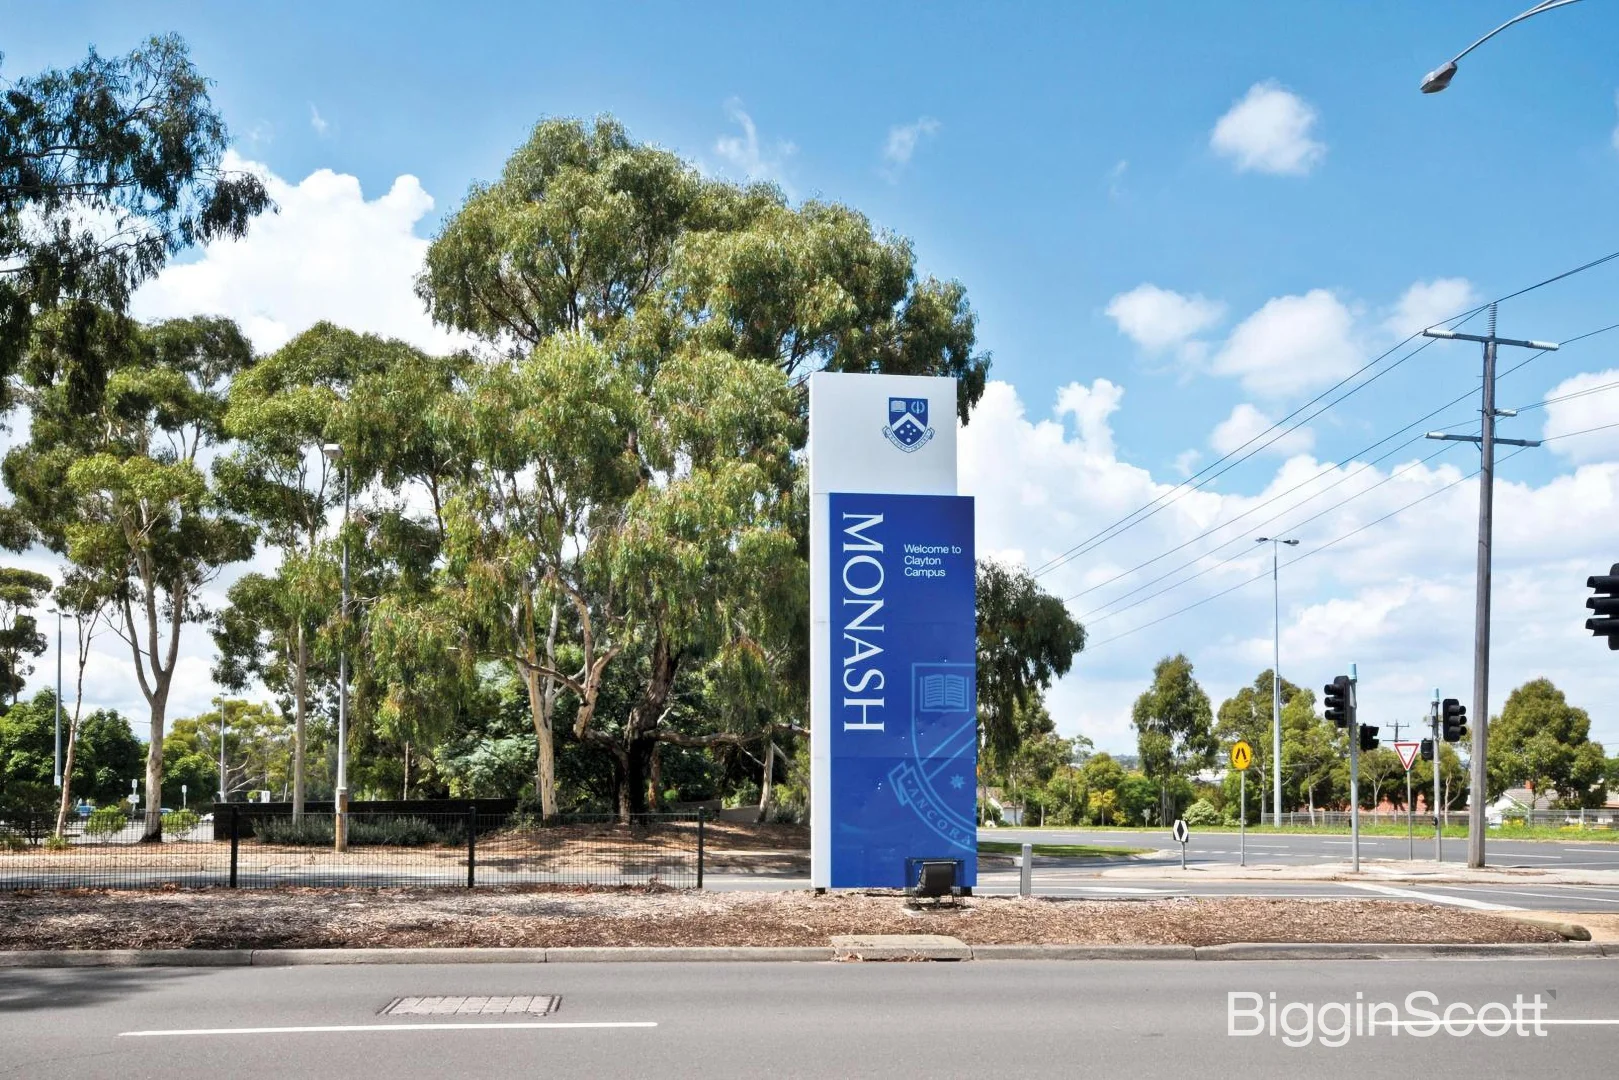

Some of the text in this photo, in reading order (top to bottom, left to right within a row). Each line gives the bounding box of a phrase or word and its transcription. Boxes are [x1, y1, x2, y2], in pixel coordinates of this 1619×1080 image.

[903, 543, 962, 554] Welcome to
[904, 555, 941, 567] Clayton
[904, 566, 946, 579] Campus
[842, 512, 885, 733] MONASH
[907, 787, 971, 846] ANCORA
